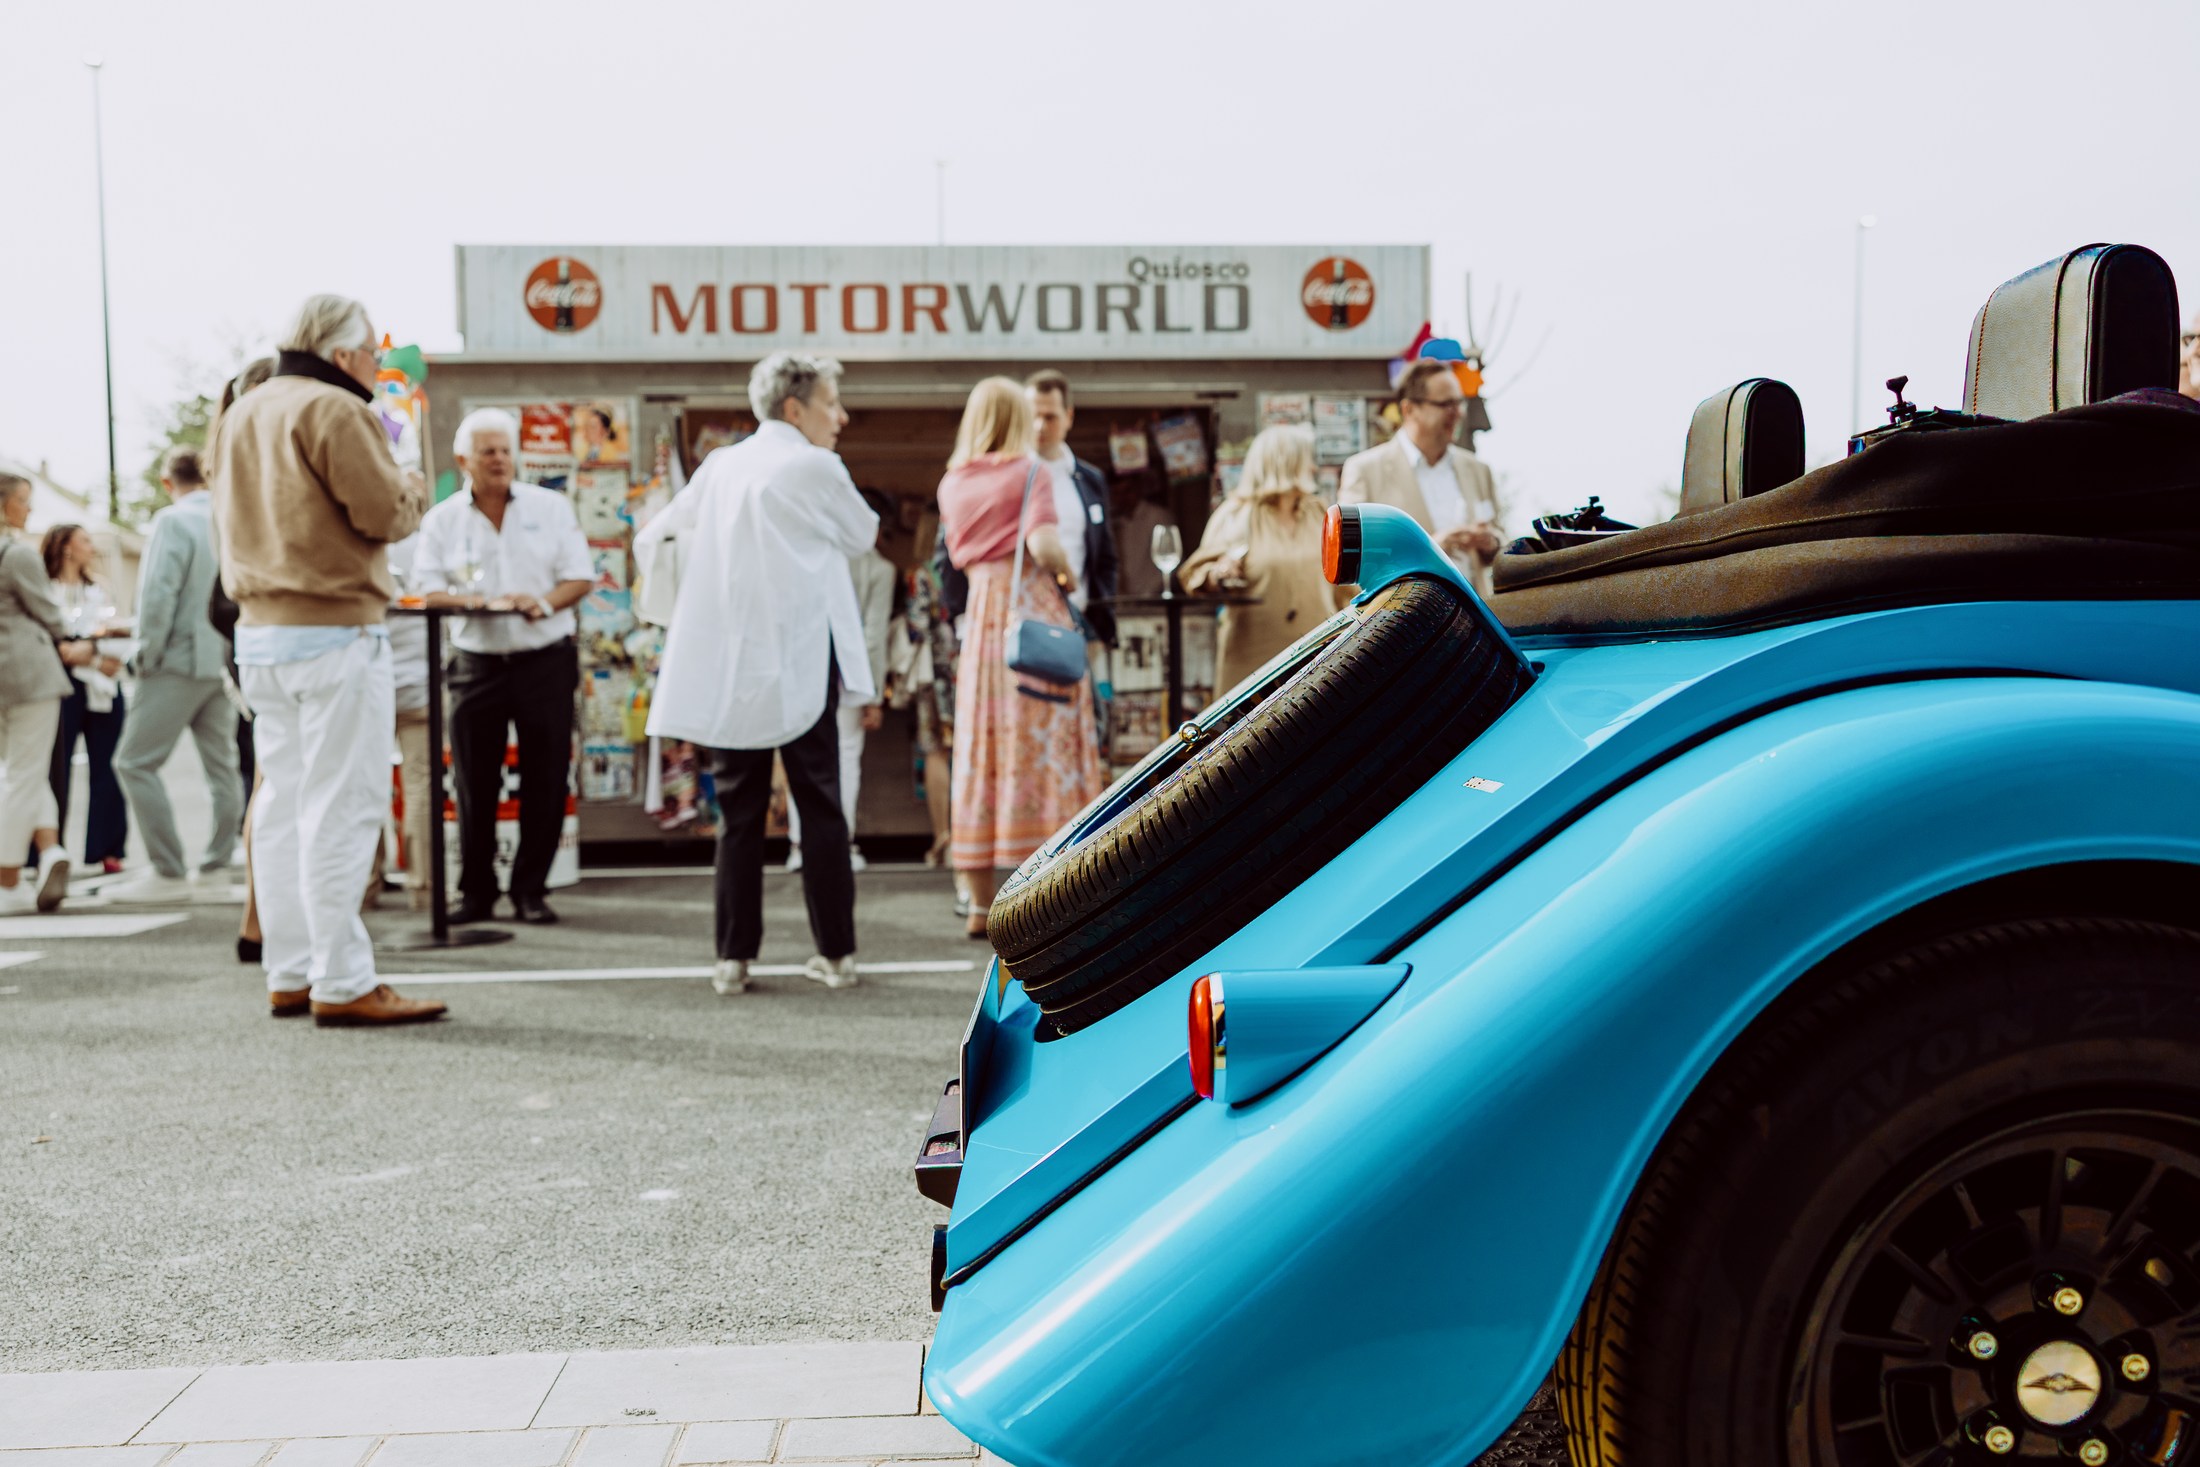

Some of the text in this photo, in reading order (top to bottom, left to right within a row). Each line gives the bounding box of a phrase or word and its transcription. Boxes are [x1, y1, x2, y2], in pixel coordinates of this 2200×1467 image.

[1128, 256, 1249, 284] Quiosco
[651, 283, 1249, 333] MOTORWORLD
[1831, 1003, 2036, 1156] AVON
